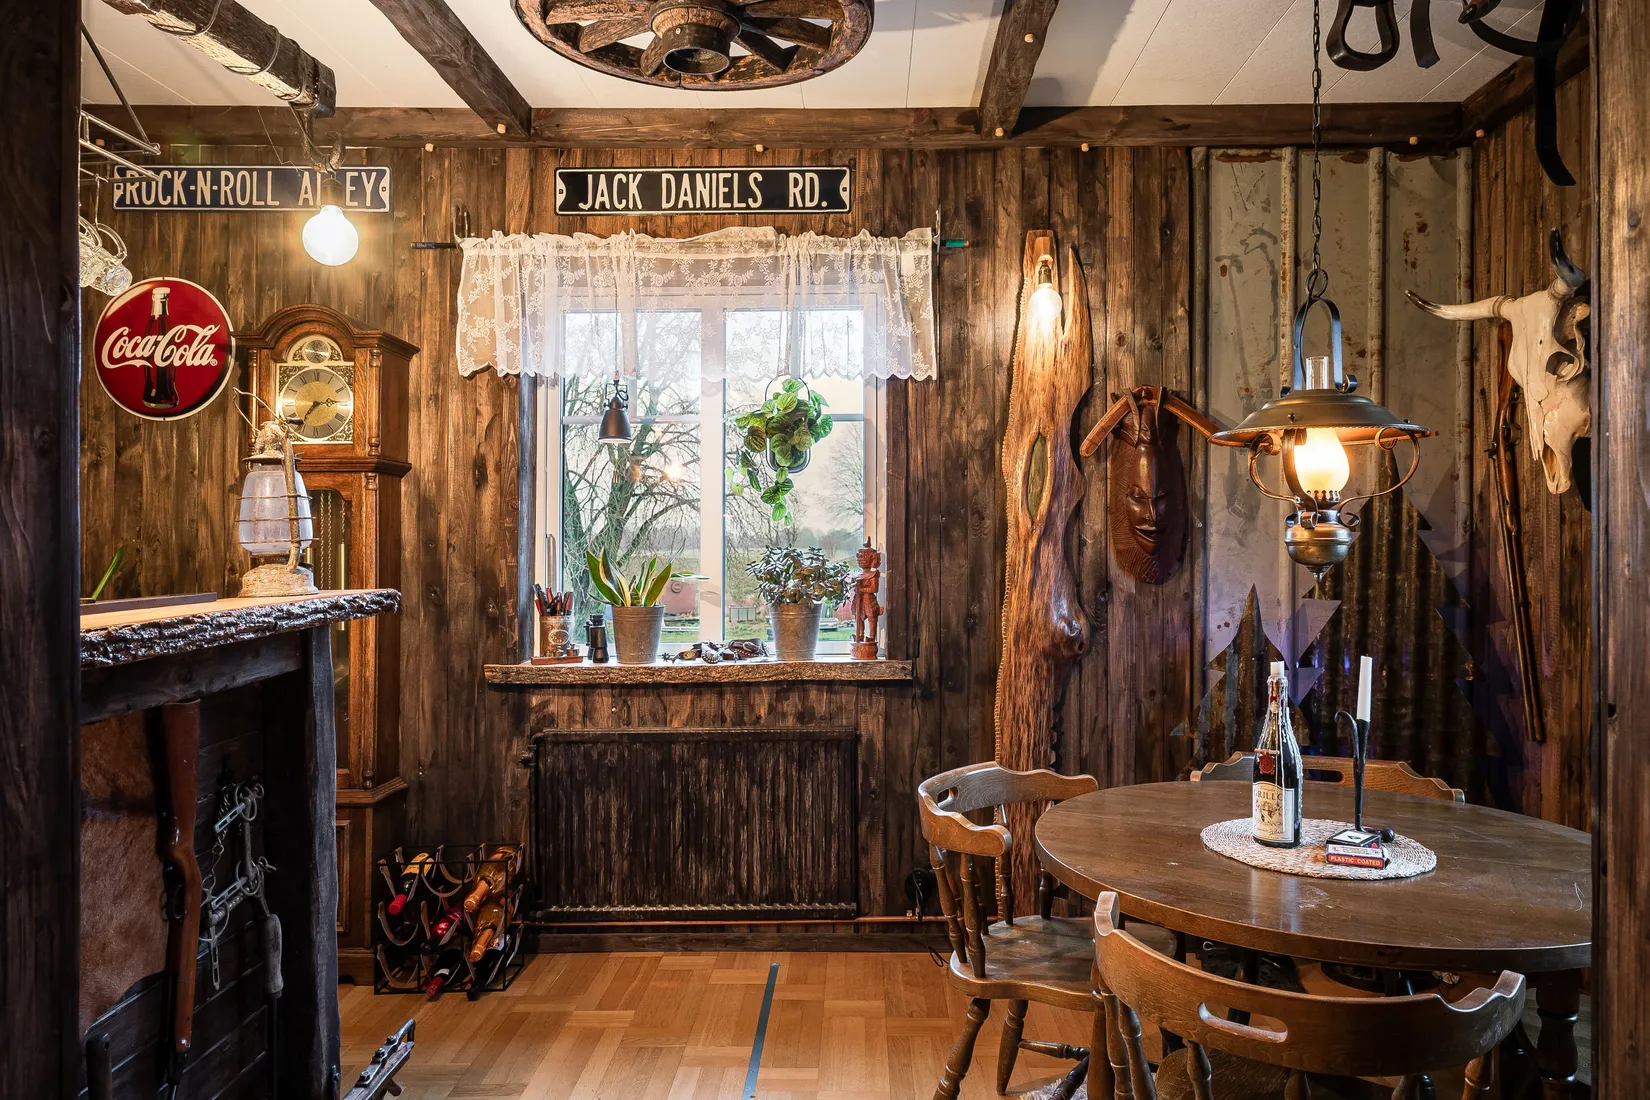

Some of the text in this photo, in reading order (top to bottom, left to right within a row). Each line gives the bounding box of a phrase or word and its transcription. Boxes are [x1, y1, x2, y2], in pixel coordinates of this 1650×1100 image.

[125, 169, 280, 206] ROCK-N-ROLL
[577, 171, 829, 211] JACK DANIELS RD.
[101, 324, 221, 370] Coca-Cola
[1330, 855, 1381, 866] PLASTIC COATED
